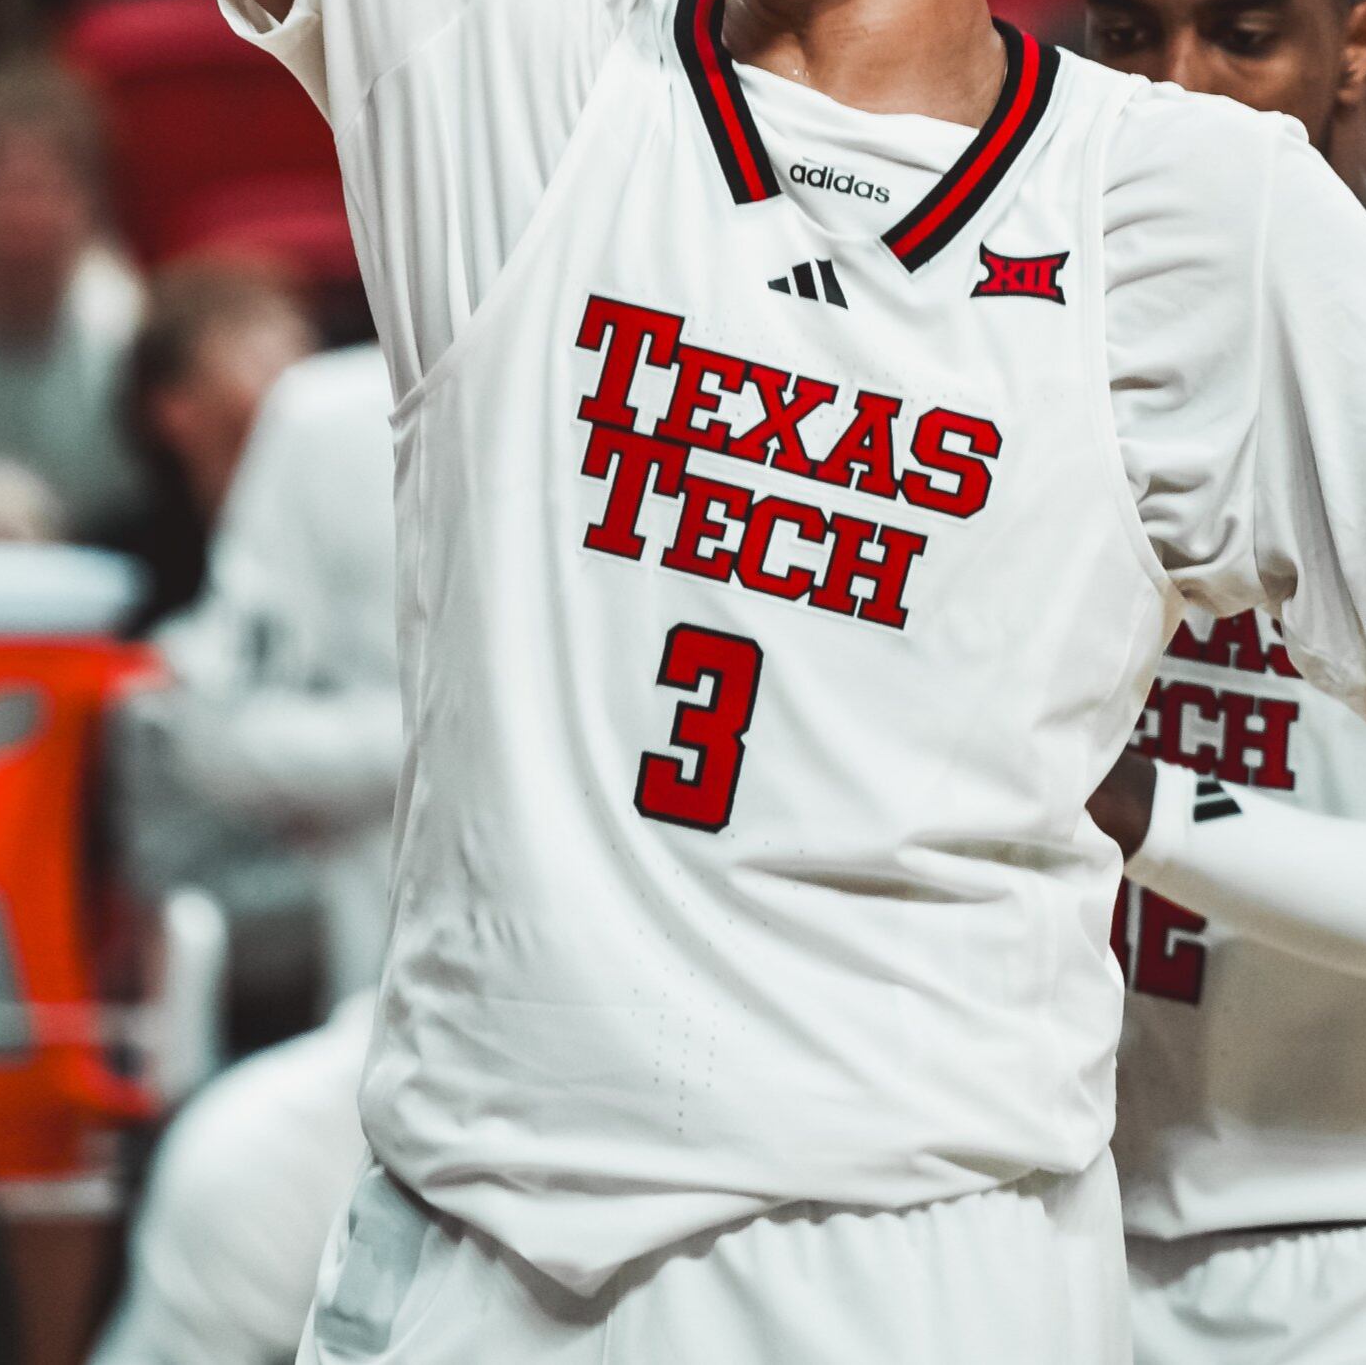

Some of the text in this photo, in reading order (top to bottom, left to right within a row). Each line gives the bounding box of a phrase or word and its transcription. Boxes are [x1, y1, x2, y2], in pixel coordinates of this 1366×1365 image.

[789, 163, 891, 204] adidas
[575, 294, 1004, 520] TEXAS
[580, 423, 928, 631] TECH
[633, 621, 764, 835] 3
